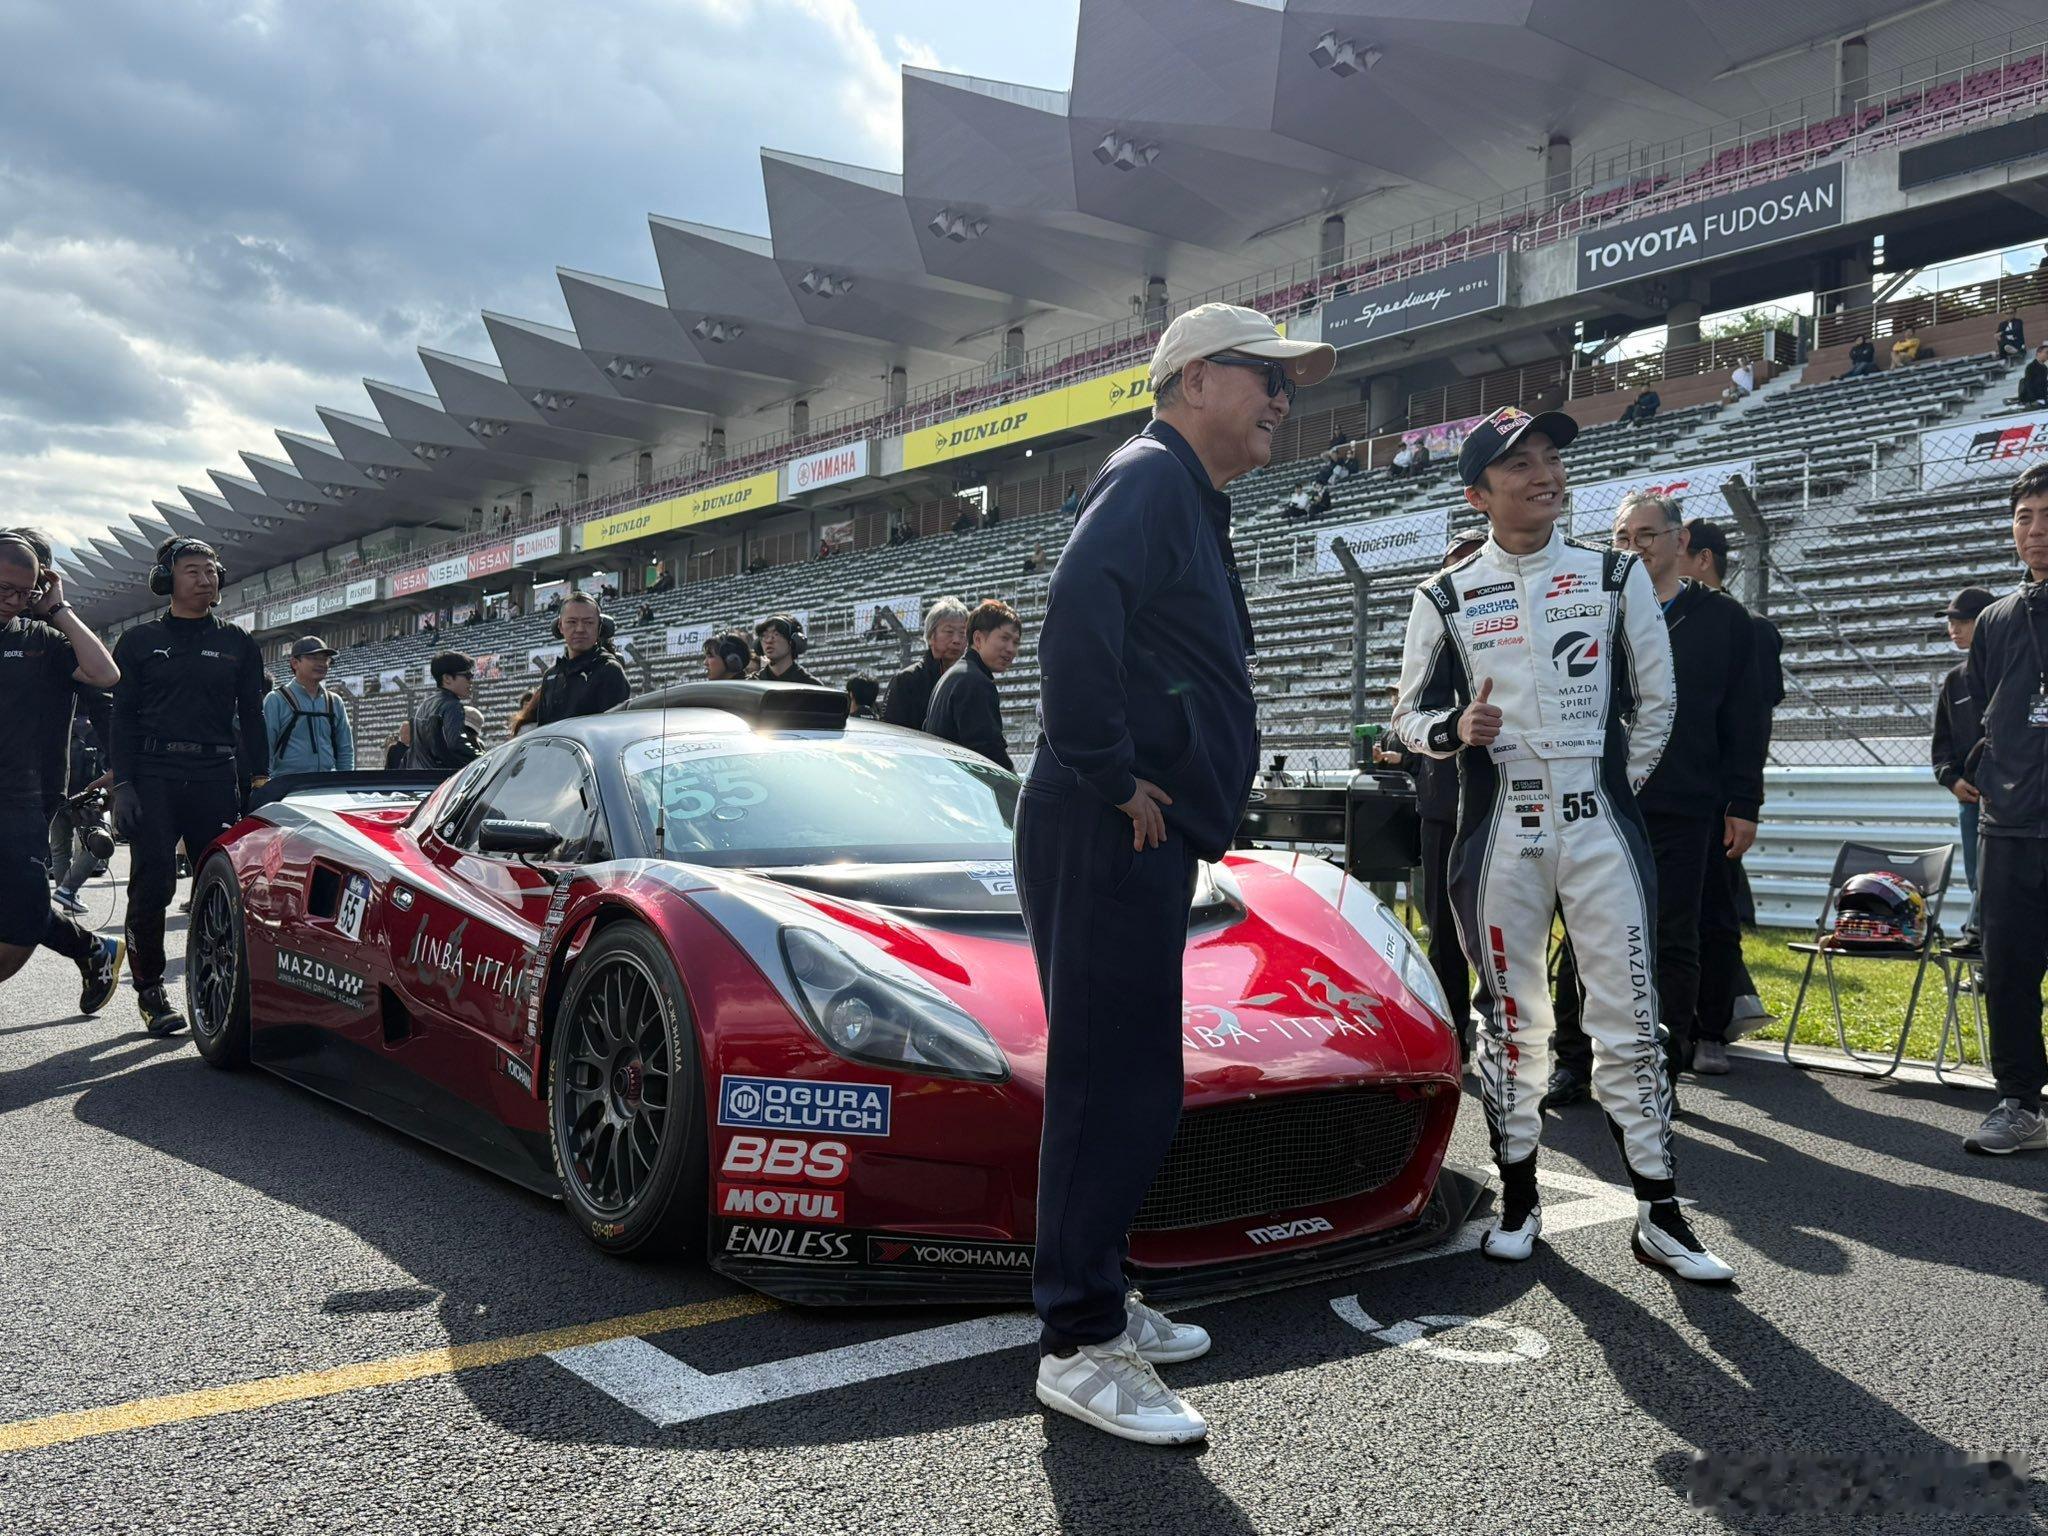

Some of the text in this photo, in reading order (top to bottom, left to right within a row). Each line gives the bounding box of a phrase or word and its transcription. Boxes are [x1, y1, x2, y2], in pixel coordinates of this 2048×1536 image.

[1585, 183, 1834, 272] TOYOTA FUDOSAN
[1329, 280, 1489, 329] FUJI Speedway HOTEL
[949, 412, 1028, 447] DUNLOP
[810, 451, 856, 482] YAMAHA
[701, 488, 752, 512] DUNLOP
[609, 515, 651, 536] DUNLOP
[526, 534, 558, 556] DAIHATSU
[1349, 529, 1421, 555] RIDGESTONE
[429, 562, 467, 581] NISSAN
[469, 550, 511, 572] NISSAN
[393, 571, 428, 591] NISSAN
[1476, 583, 1513, 595] YOKOHAMA
[1478, 598, 1519, 609] OGURA
[1478, 604, 1519, 615] CLUTCH
[1545, 603, 1602, 623] KeePer
[1472, 615, 1518, 636] BBS
[1473, 639, 1496, 651] ROOKIE
[1558, 684, 1599, 696] MAZDA
[1560, 697, 1593, 709] SPIRIT
[1561, 709, 1599, 721] RACING
[660, 768, 768, 820] 55
[1507, 794, 1550, 802] RAIDILLON
[1562, 791, 1599, 822] 55
[340, 893, 361, 934] 55
[278, 951, 337, 987] MAZDA
[411, 932, 523, 999] JINBA-ITTAI
[1626, 925, 1648, 1002] MAZDA
[1182, 1014, 1377, 1050] NBA-ITTAI
[765, 1086, 882, 1110] OGURA
[764, 1105, 882, 1129] CLUTCH
[721, 1135, 849, 1182] BBS
[723, 1188, 839, 1219] MOTUL
[725, 1224, 853, 1259] ENDLESS
[912, 1245, 1031, 1267] YOKOHAMA
